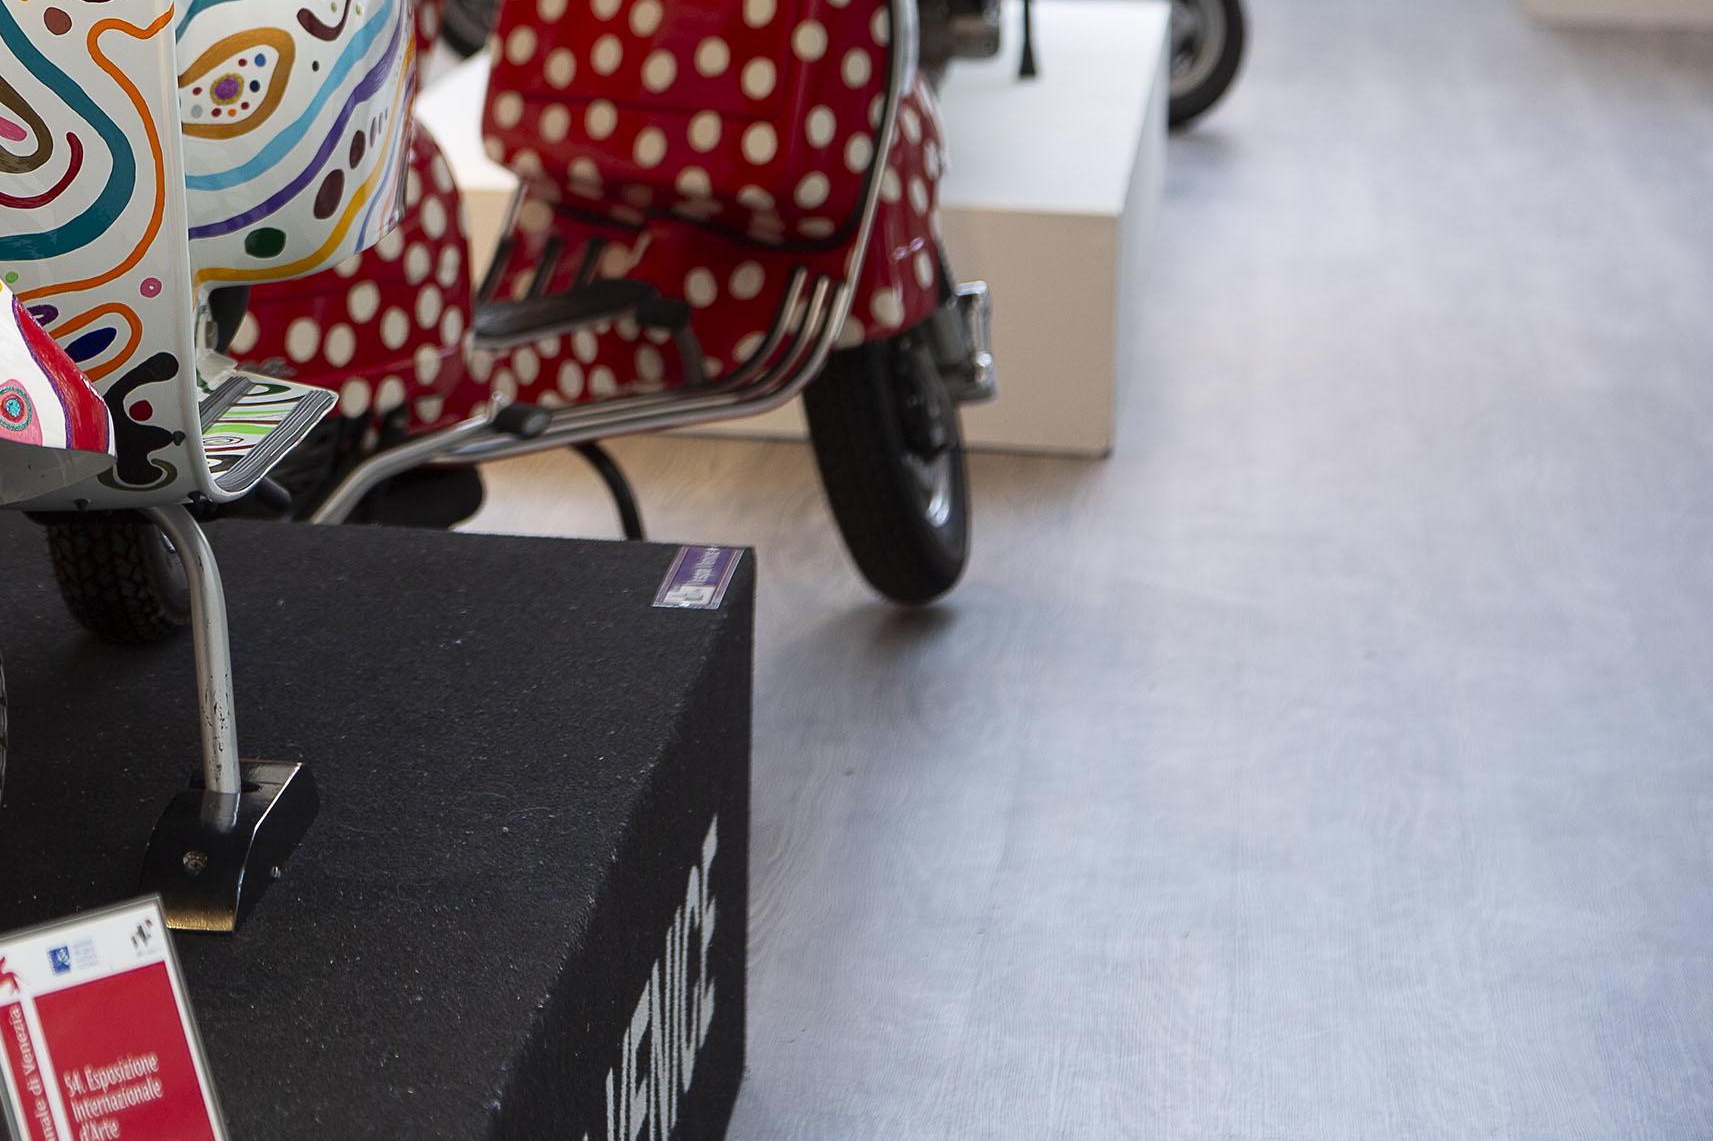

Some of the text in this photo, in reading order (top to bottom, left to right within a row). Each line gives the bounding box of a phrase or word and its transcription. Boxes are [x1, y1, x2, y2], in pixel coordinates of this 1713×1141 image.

[10, 1005, 56, 1141] nale di Venezia
[63, 1053, 159, 1098] 54. Esposizione
[71, 1076, 163, 1123] Internazionale
